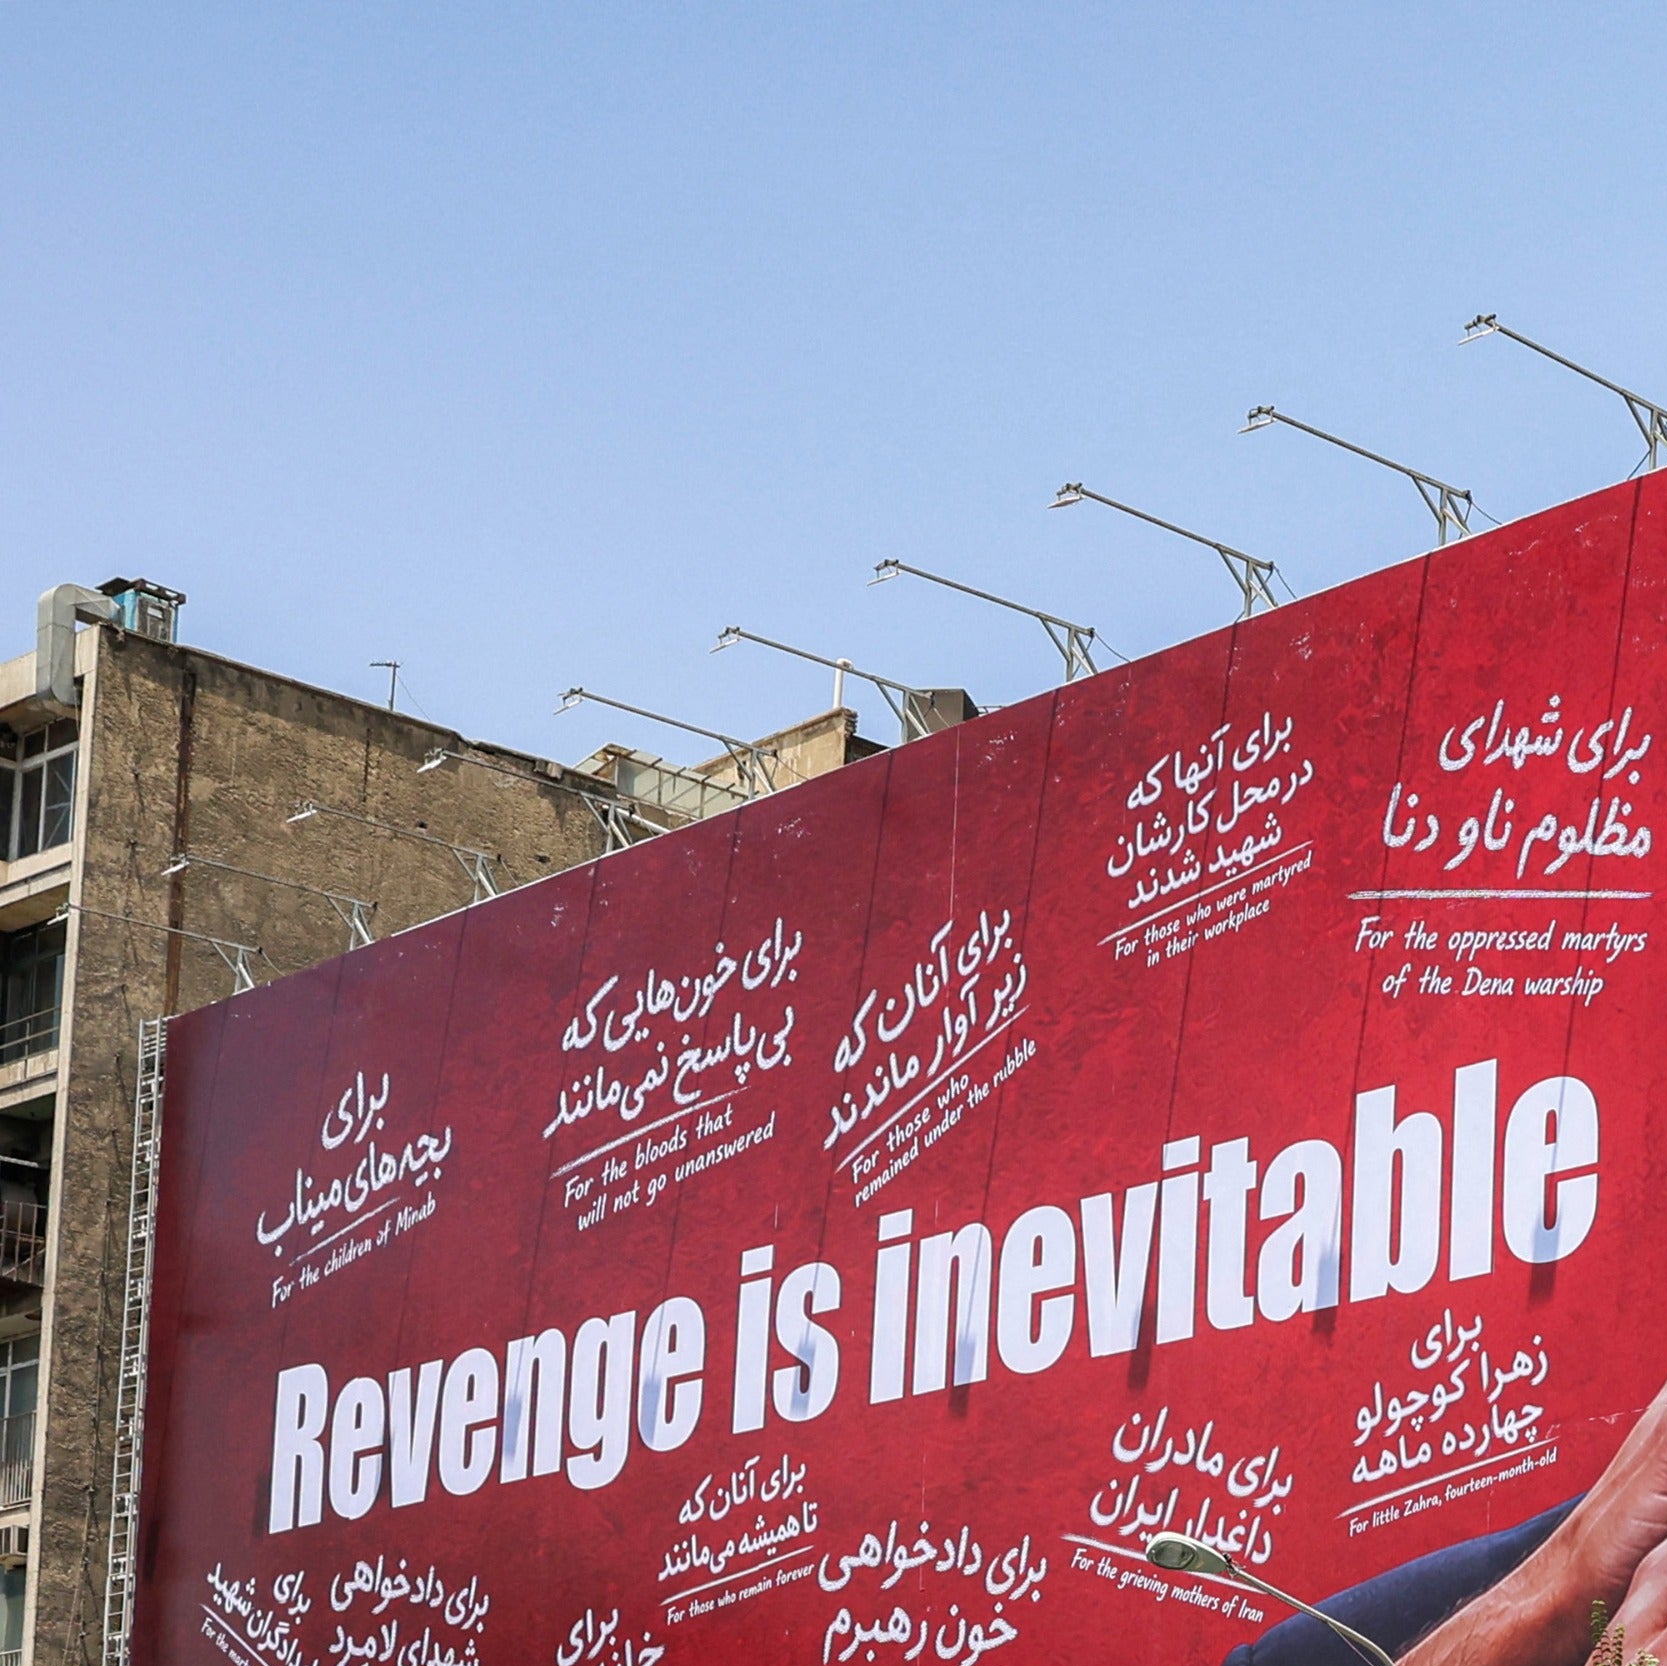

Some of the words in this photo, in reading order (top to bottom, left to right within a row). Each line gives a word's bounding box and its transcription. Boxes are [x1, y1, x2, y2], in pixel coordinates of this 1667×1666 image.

[1439, 695, 1563, 771] شهدای
[1567, 706, 1651, 785] برای
[1383, 782, 1439, 851] دنا
[1444, 788, 1514, 870] ناو
[1517, 797, 1651, 879] مظلوم
[1115, 937, 1139, 960] For
[1144, 919, 1180, 946] those
[1186, 903, 1212, 926] who
[1216, 888, 1246, 912] were
[1252, 850, 1312, 895] martyred
[1147, 949, 1160, 967] in
[1165, 930, 1199, 958] their
[1204, 899, 1269, 940] workplace
[1355, 916, 1394, 952] For
[1404, 921, 1438, 950] the
[1448, 920, 1556, 962] oppressed
[1561, 922, 1648, 963] martyrs
[1382, 963, 1411, 998] of
[1419, 965, 1452, 994] the
[1461, 966, 1514, 996] Dena
[1524, 966, 1603, 1007] warship
[322, 1071, 389, 1150] برای
[852, 1136, 919, 1208] remained
[921, 1104, 964, 1148] under
[967, 1082, 990, 1108] the
[993, 1038, 1036, 1088] rubble
[852, 1150, 880, 1184] For
[886, 1107, 933, 1152] those
[937, 1074, 969, 1109] who
[564, 1175, 597, 1208] For
[601, 1157, 627, 1186] the
[635, 1124, 687, 1170] bloods
[695, 1103, 733, 1140] that
[578, 1193, 607, 1231] will
[613, 1180, 640, 1213] not
[646, 1174, 667, 1206] go
[675, 1111, 775, 1182] unanswered
[272, 1276, 295, 1308] For
[299, 1264, 320, 1290] the
[324, 1238, 372, 1277] children
[376, 1228, 393, 1250] of
[395, 1191, 436, 1236] Minab
[269, 1294, 707, 1534] Revenge
[731, 1245, 842, 1435] is
[869, 1058, 1601, 1405] inevitable
[1411, 1308, 1482, 1369] برای
[1481, 1335, 1548, 1403] زهرا
[1113, 1406, 1224, 1477] مادران
[1353, 1359, 1475, 1450] کوچولو
[1442, 1404, 1543, 1457] چهارده
[1227, 1446, 1293, 1519] برای
[1350, 1517, 1369, 1537] For
[1372, 1505, 1400, 1527] little
[1403, 1495, 1442, 1517] Zahra,
[1436, 1438, 1557, 1501] fourteen-month-old
[1352, 1435, 1432, 1483] ماهه
[818, 1520, 982, 1592] دادخواهی
[986, 1535, 1047, 1602] برای
[1071, 1548, 1094, 1571] For
[1097, 1557, 1118, 1579] the
[1117, 1569, 1169, 1601] grieving
[1171, 1585, 1220, 1610] mothers
[1221, 1595, 1239, 1618] of
[1238, 1599, 1264, 1623] Iran
[667, 1606, 685, 1625] For
[689, 1599, 715, 1617] those
[717, 1590, 736, 1607] who
[739, 1576, 772, 1601] remain
[776, 1564, 815, 1586] forever
[823, 1607, 929, 1665] رهبرم
